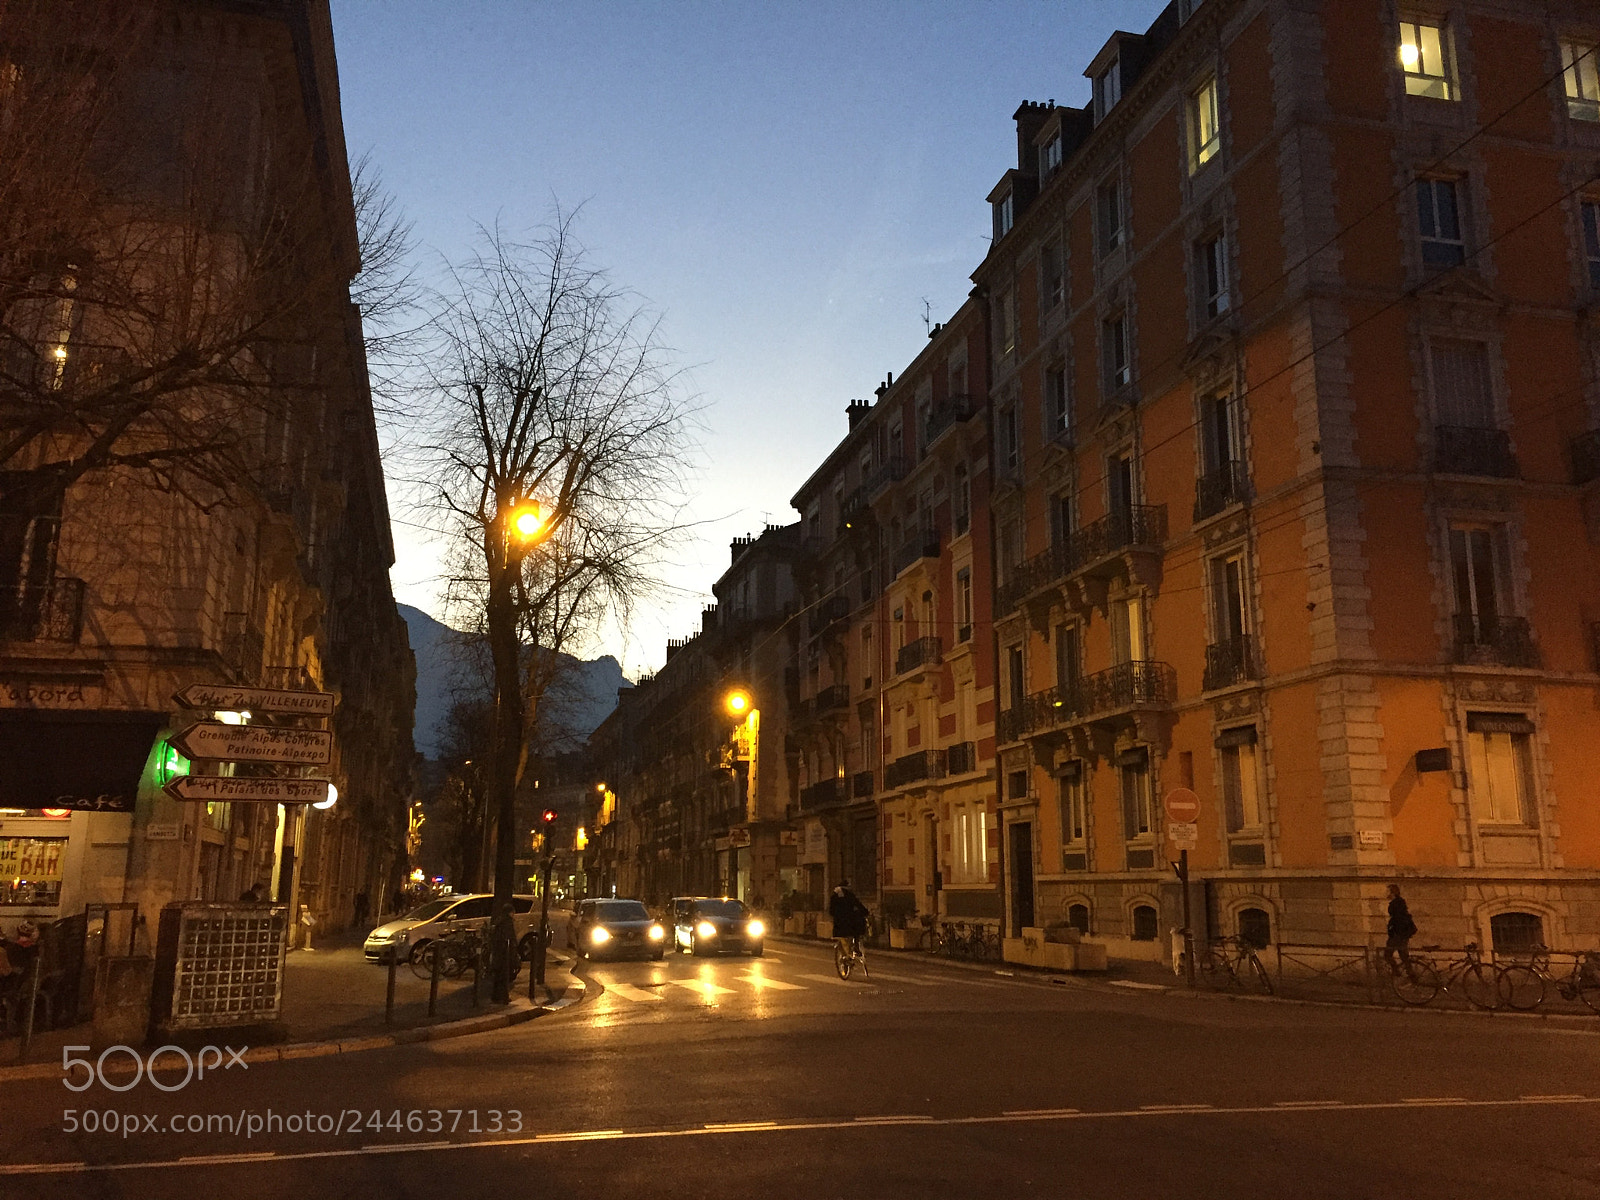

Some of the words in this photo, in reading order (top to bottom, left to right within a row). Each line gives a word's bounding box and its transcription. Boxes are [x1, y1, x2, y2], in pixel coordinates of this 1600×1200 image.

[220, 784, 254, 795] Palais
[261, 784, 280, 795] des
[55, 794, 124, 810] Café
